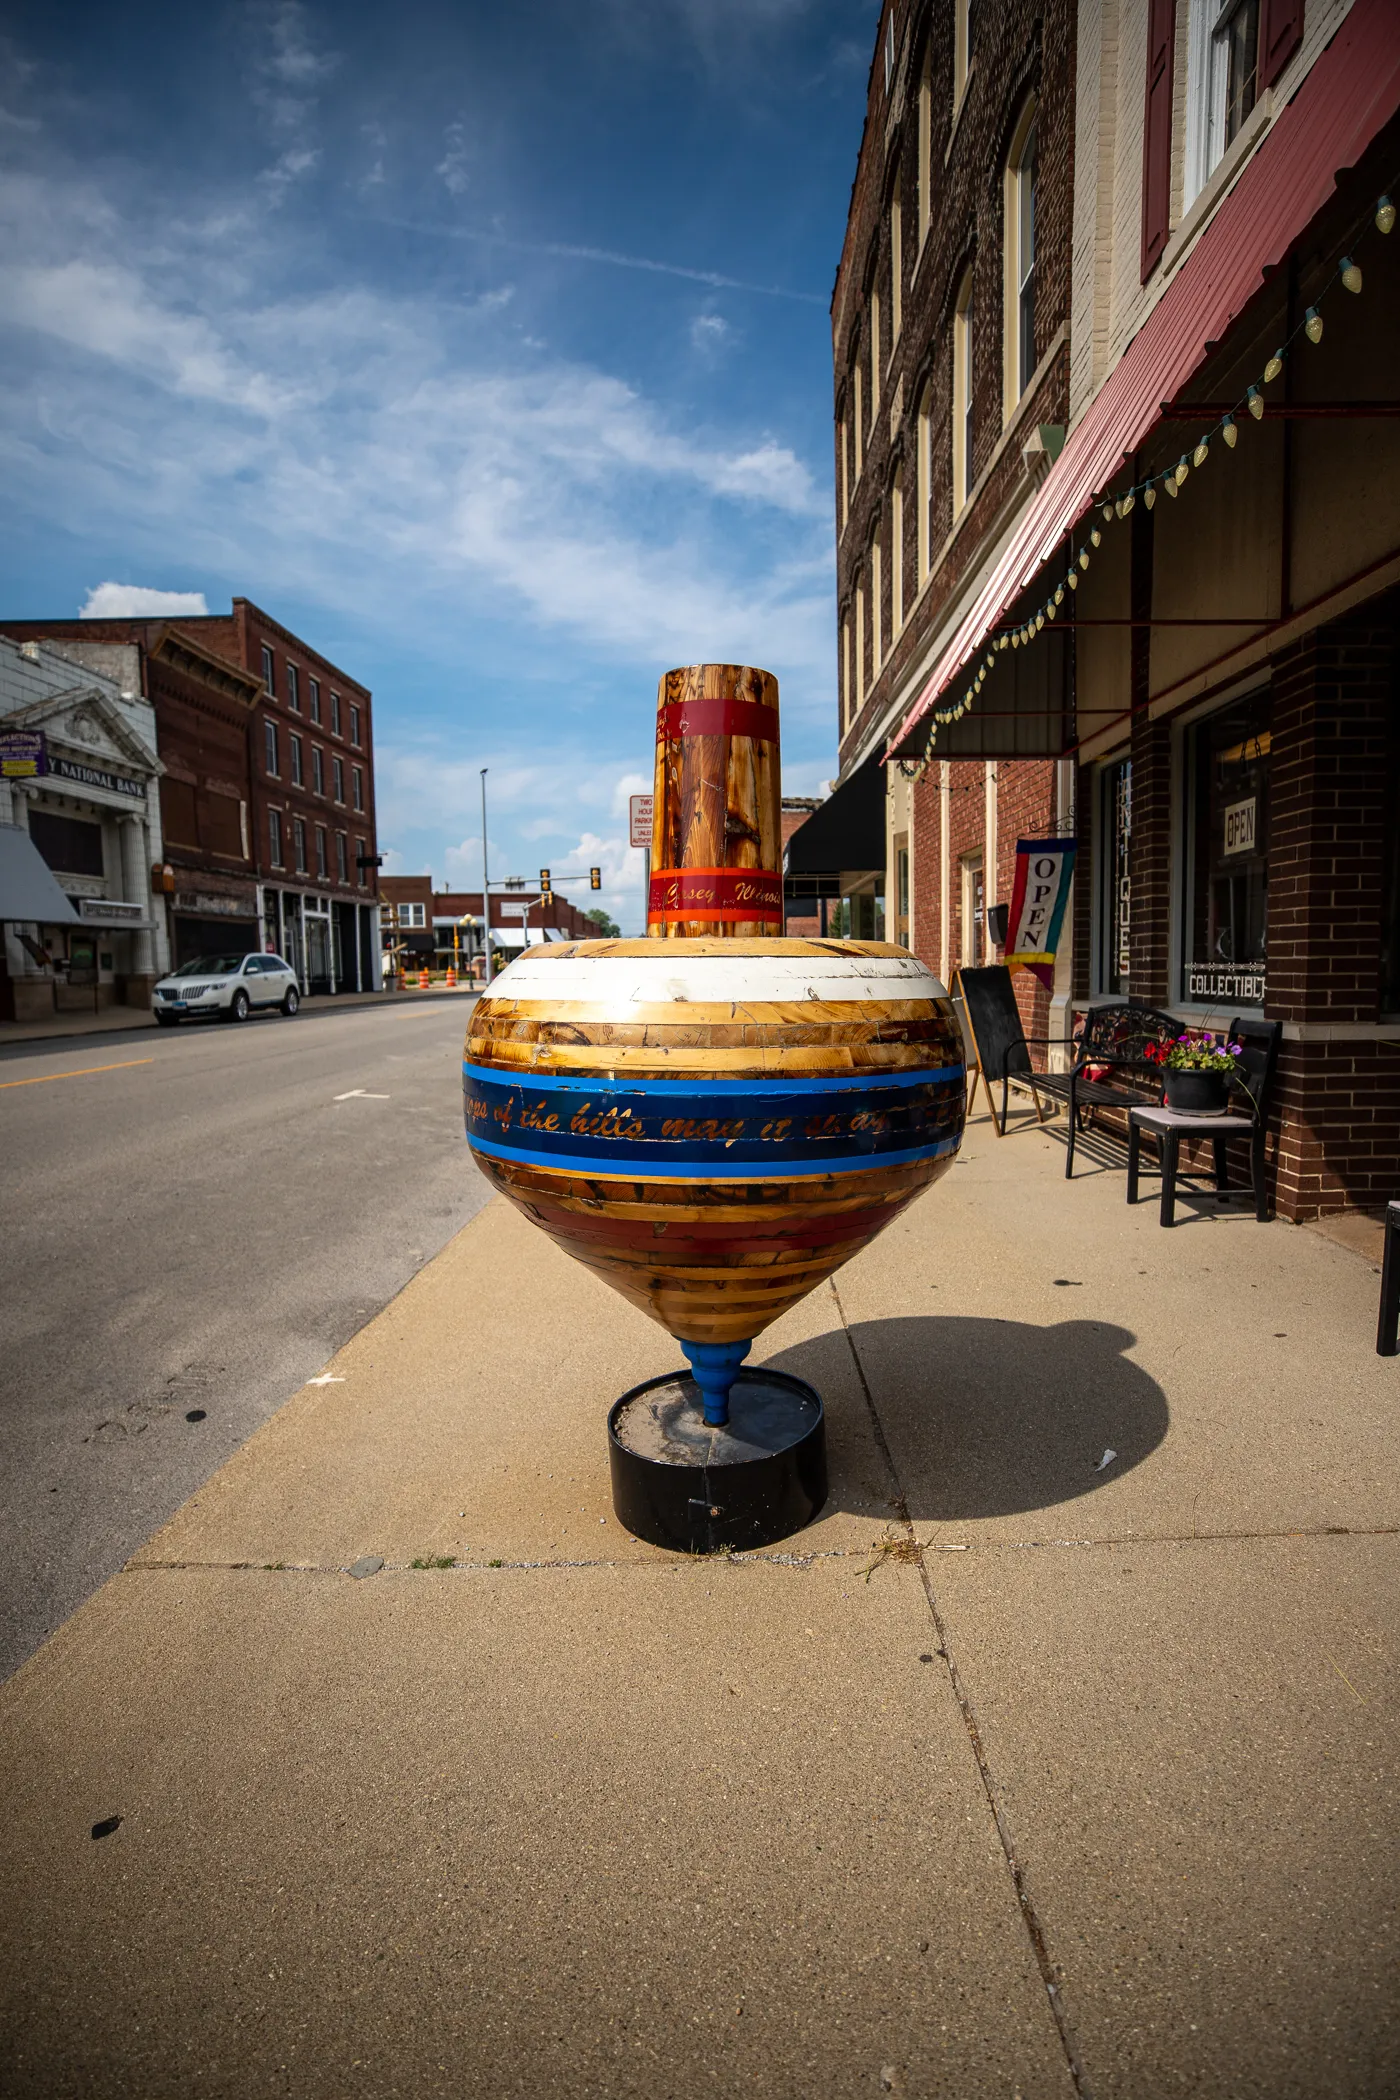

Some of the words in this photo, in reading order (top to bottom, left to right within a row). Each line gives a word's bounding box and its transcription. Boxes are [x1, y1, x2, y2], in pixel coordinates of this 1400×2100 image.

[61, 761, 116, 789] NATIONAL
[117, 778, 144, 797] BANK
[1227, 805, 1254, 847] OPEN
[1119, 778, 1131, 975] ANTIQUES
[1021, 858, 1055, 947] OPEN
[520, 1100, 560, 1132] the
[570, 1102, 646, 1138] hills
[661, 1119, 745, 1148] may
[760, 1117, 792, 1142] it
